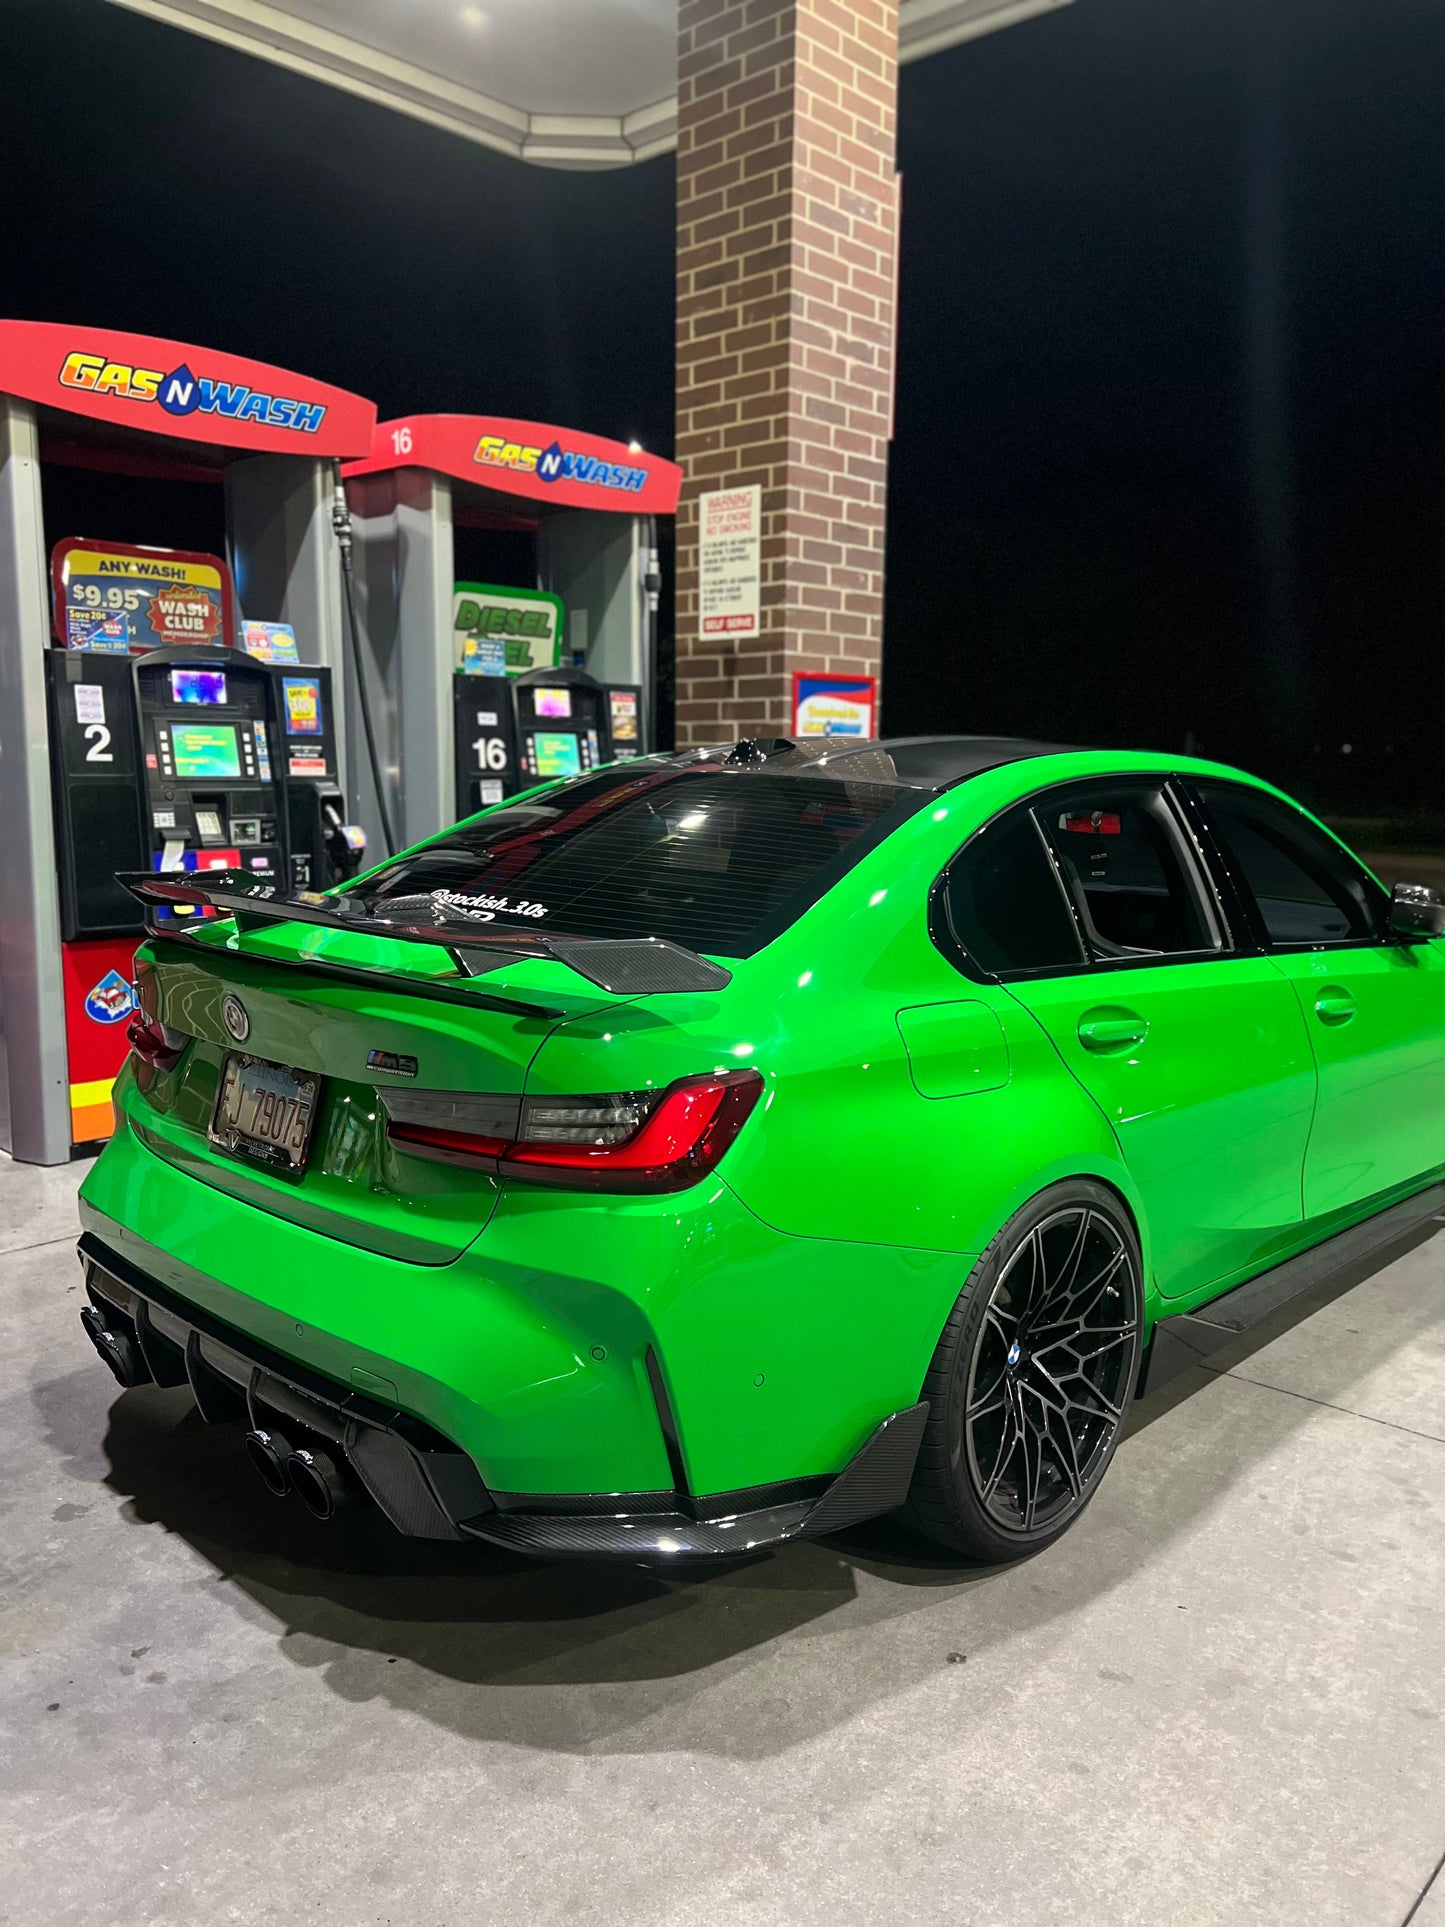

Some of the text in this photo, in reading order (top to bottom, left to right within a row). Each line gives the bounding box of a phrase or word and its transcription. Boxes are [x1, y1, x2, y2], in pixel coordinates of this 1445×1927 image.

[59, 351, 326, 433] GAS N WASH
[391, 427, 412, 455] 16
[473, 435, 648, 493] GAS N WASH
[98, 560, 186, 580] ANY WASH!
[72, 583, 139, 610] $9.95
[158, 600, 209, 617] WASH
[69, 609, 90, 618] Save
[164, 615, 205, 631] CLUB
[455, 599, 552, 639] DIESEL
[84, 724, 113, 762] 2
[472, 737, 507, 770] 16
[250, 1088, 310, 1148] 79075
